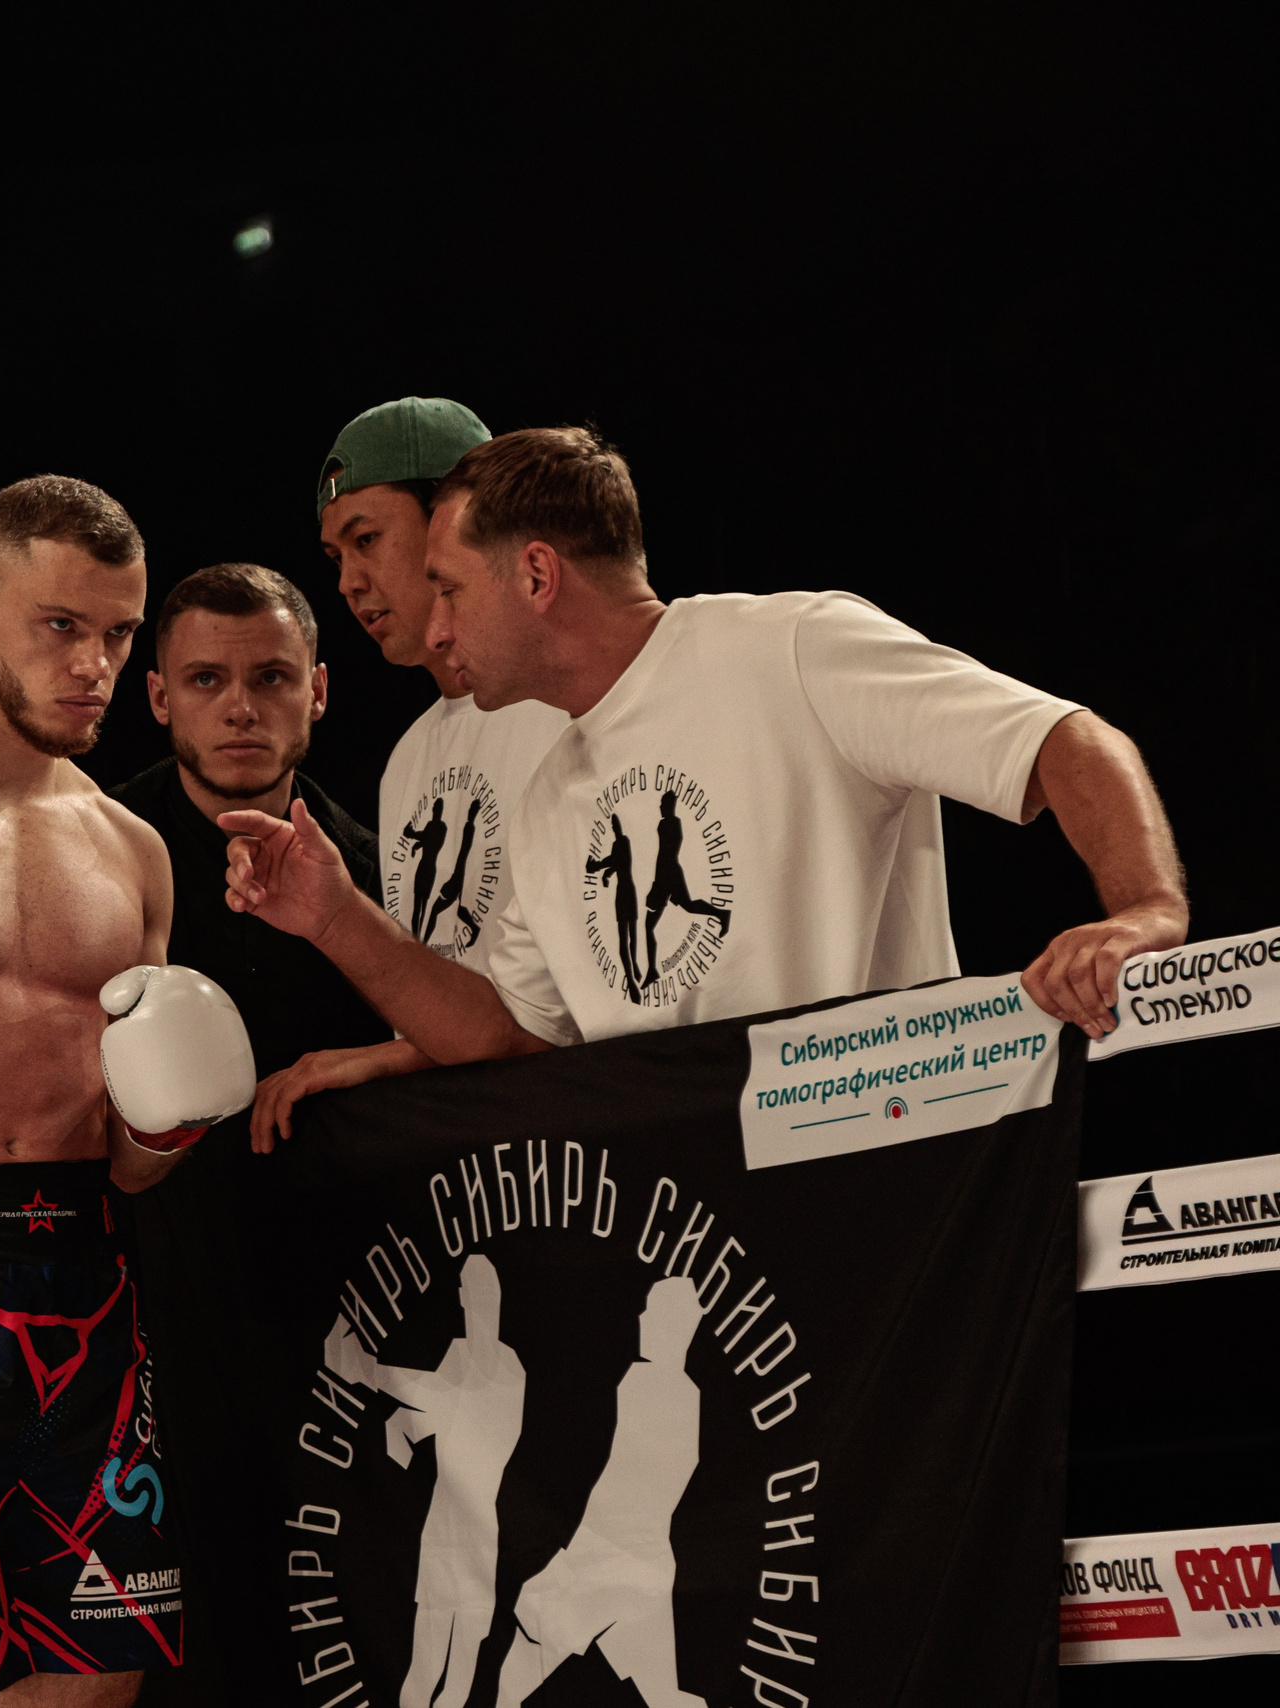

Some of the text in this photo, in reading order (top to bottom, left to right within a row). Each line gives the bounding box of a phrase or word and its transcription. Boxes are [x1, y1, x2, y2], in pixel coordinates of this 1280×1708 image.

[596, 765, 647, 820] СИБИРЬ
[654, 764, 710, 822] СИБИРЬ
[393, 793, 429, 863] СИИРЬ
[583, 819, 607, 901] СИИРЬ
[702, 820, 735, 908] СИБИРЬ
[1123, 937, 1280, 992] Сибирское
[780, 986, 1024, 1067] Сибирский окружной
[1131, 983, 1253, 1026] Стекло
[756, 1032, 1048, 1111] томографический центр
[21, 1210, 51, 1218] РУССКАЯ
[429, 1139, 618, 1258] СИБИРЬ
[1120, 1237, 1280, 1270] СТРОИТЕЛЬНАЯ КОМП
[637, 1176, 812, 1431] СИБИРЬ
[299, 1223, 431, 1469] СИИРЬ
[124, 1568, 180, 1593] АВАНГА
[728, 1461, 820, 1708] СИБИР
[1092, 1557, 1164, 1594] ФОНД
[71, 1603, 159, 1620] СТРОИТЕЛЬНАЯ
[1226, 1611, 1263, 1629] DRY
